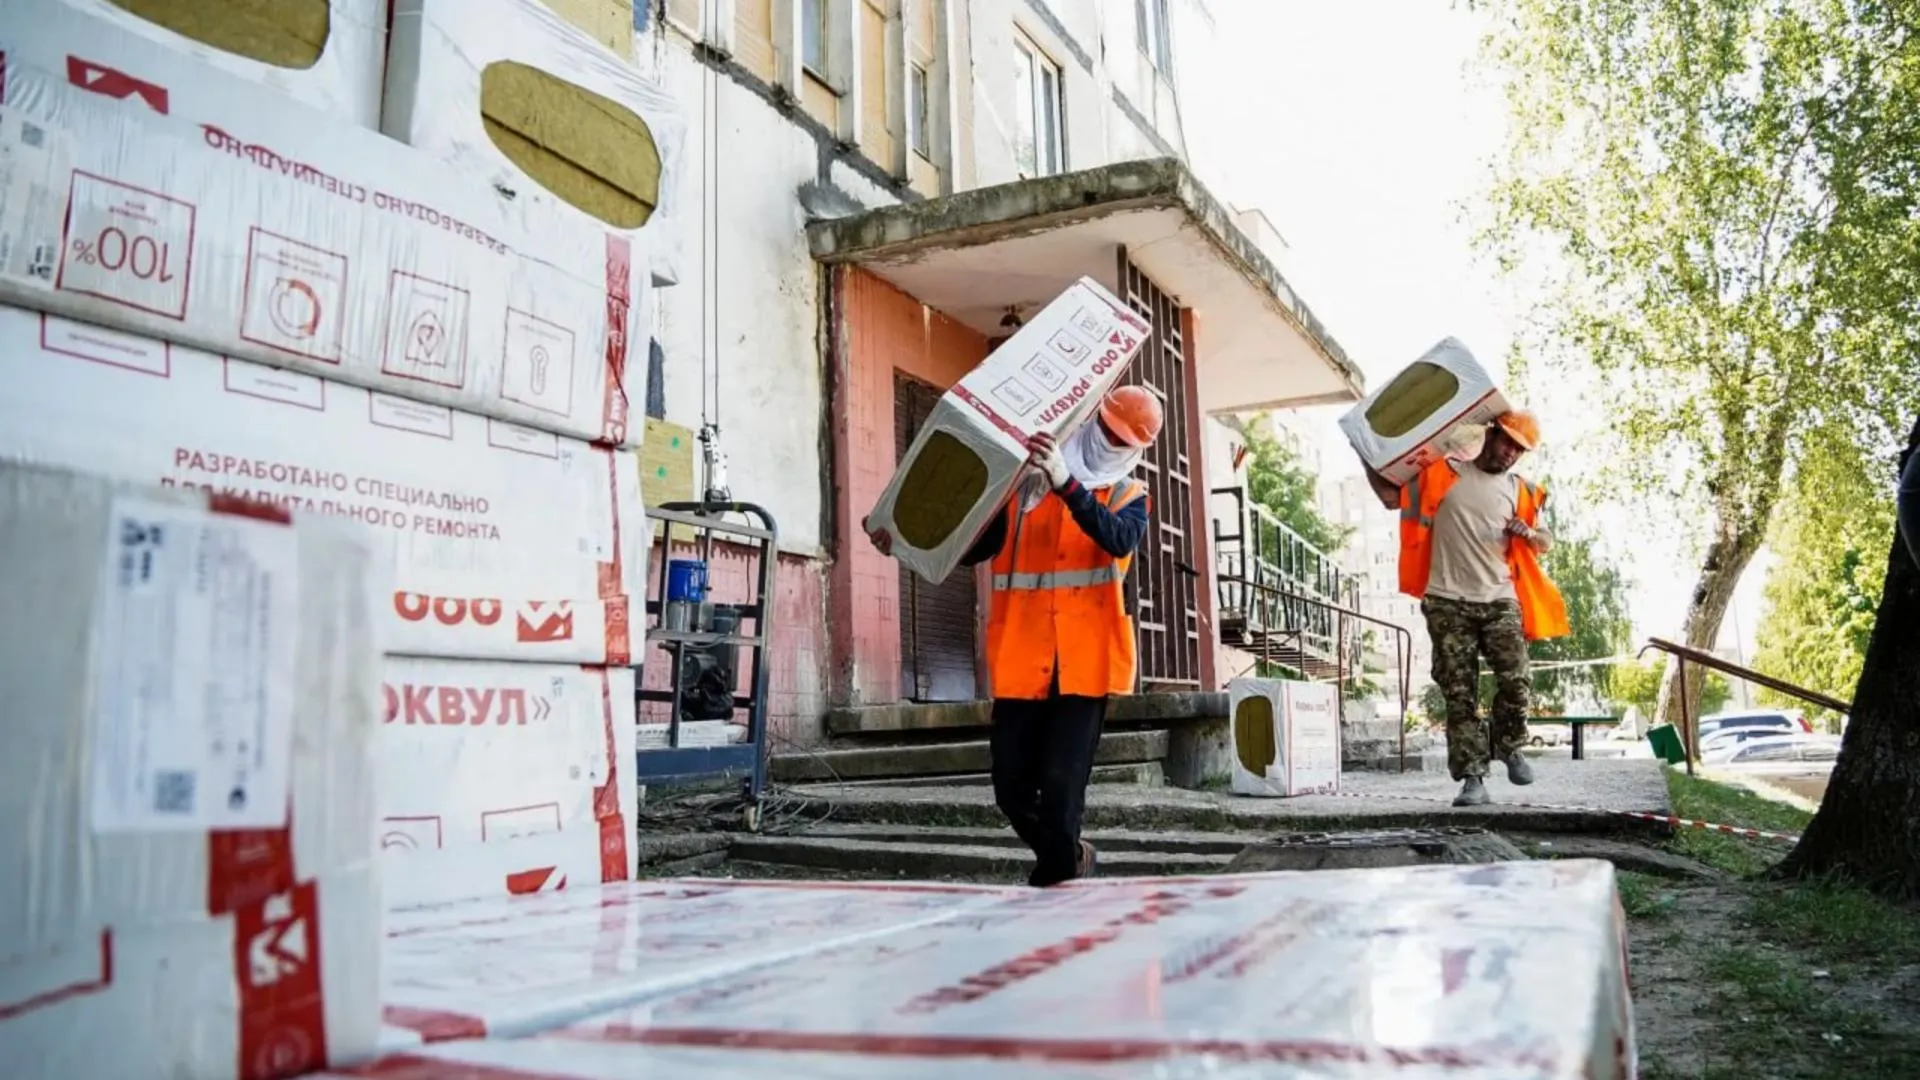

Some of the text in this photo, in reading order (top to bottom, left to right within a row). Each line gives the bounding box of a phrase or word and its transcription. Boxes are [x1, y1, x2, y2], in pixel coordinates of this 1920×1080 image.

[204, 127, 506, 256] РАЗРАБОТАНО СПЕЦИАЛЬНО
[73, 227, 173, 283] 100%
[1091, 349, 1118, 375] ООО
[175, 447, 348, 492] РАЗРАБОТАНО
[355, 477, 489, 514] СПЕЦИАЛЬНО
[414, 519, 500, 540] РЕМОНТА
